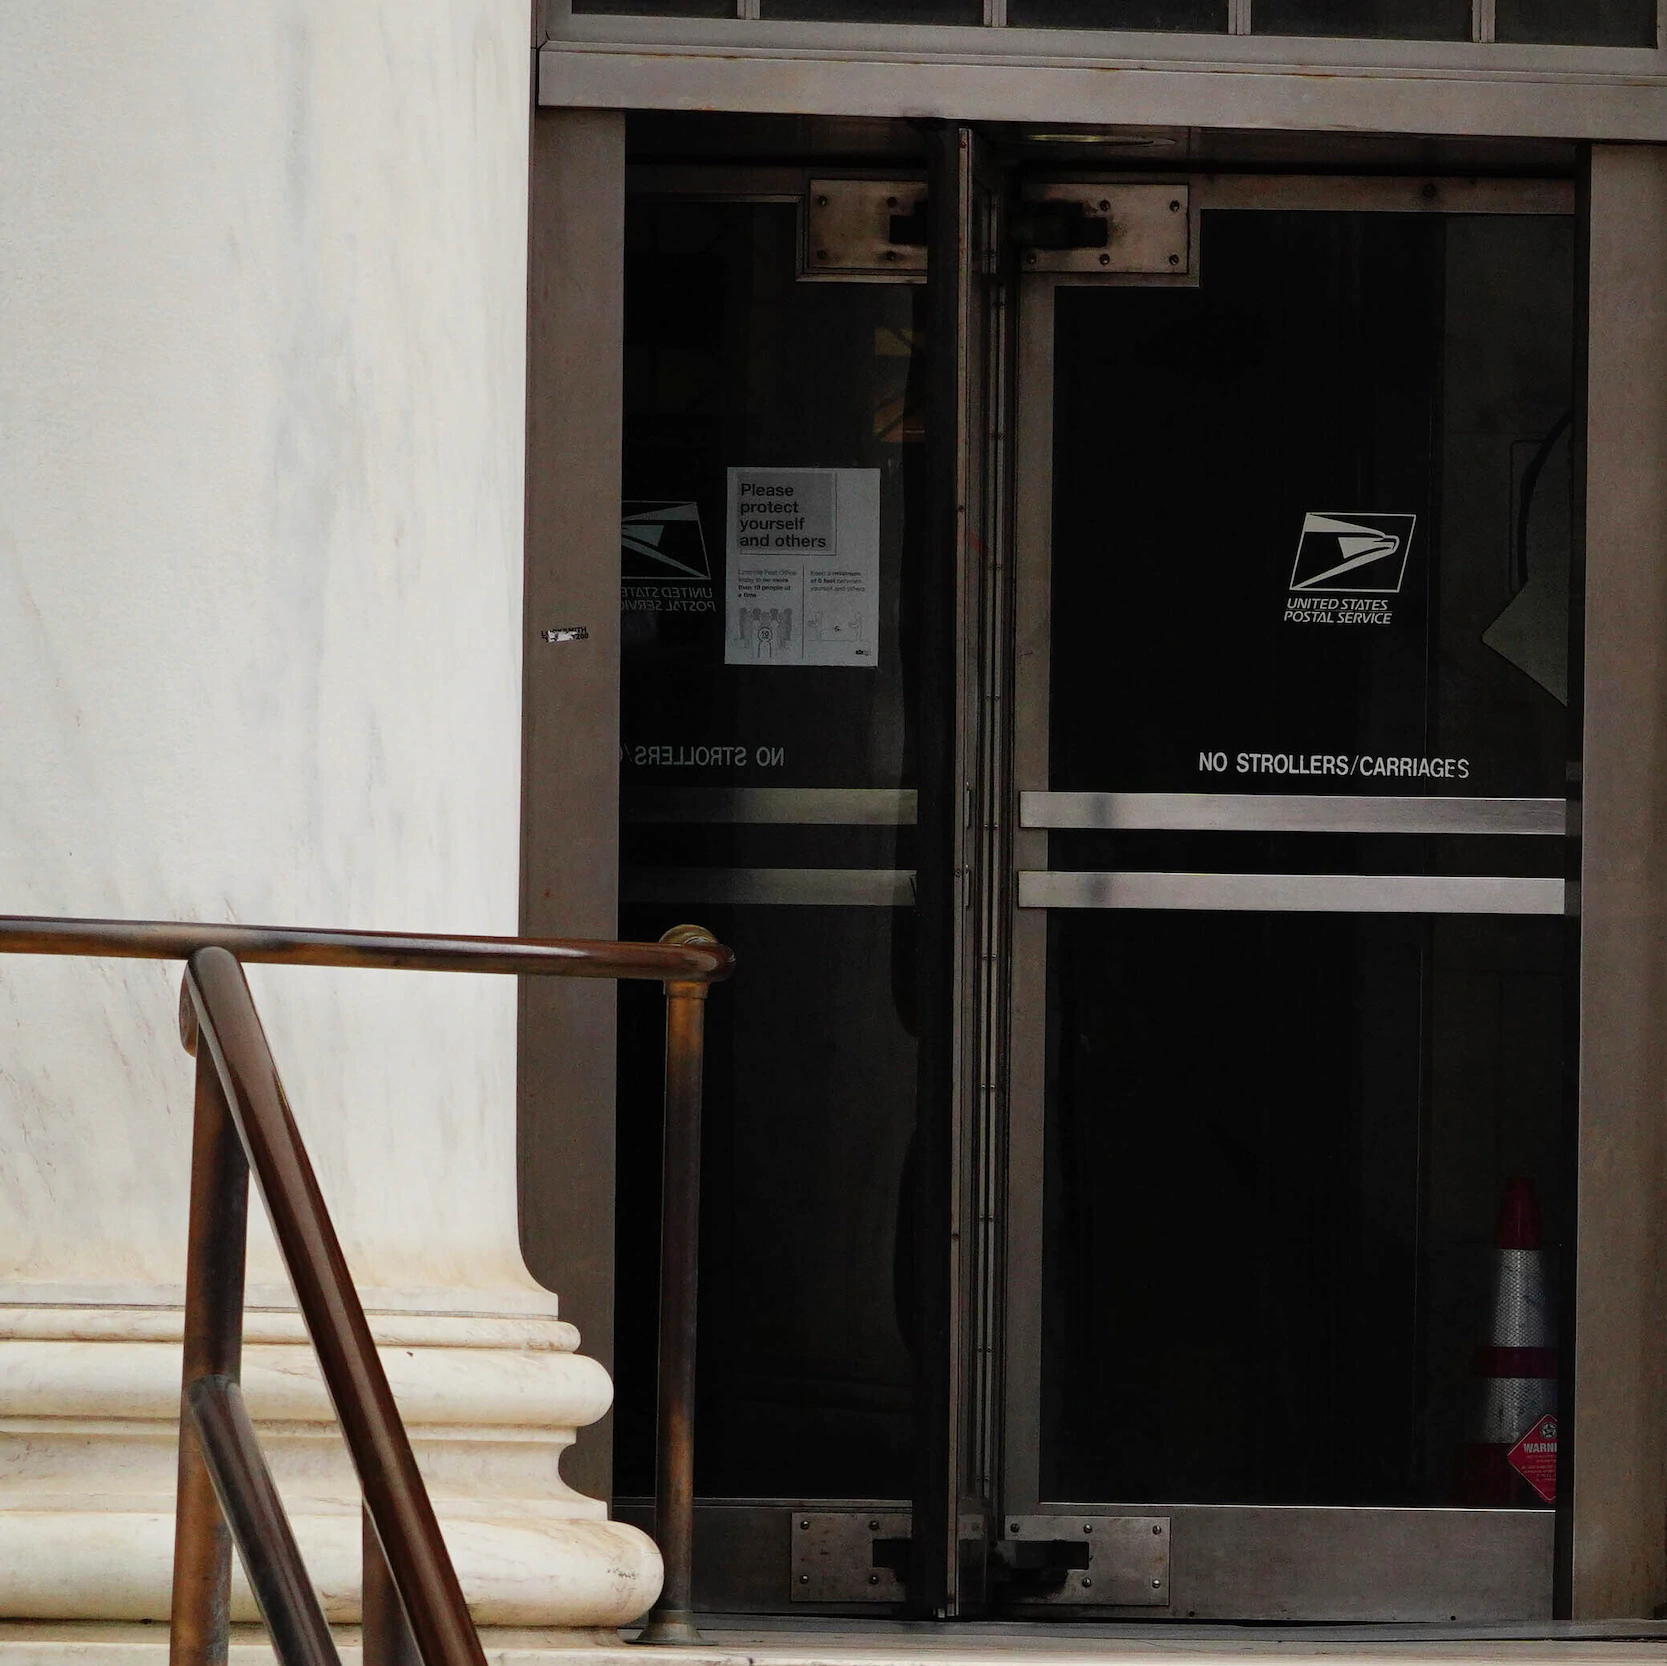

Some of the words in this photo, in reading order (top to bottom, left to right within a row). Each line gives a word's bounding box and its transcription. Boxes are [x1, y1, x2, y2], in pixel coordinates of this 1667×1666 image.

[741, 483, 794, 496] Please
[741, 500, 800, 516] protect
[740, 517, 806, 532] yourself
[740, 534, 770, 547] and
[775, 535, 827, 548] others
[1287, 598, 1339, 611] UNITED
[1341, 599, 1389, 611] STATES
[1283, 611, 1335, 624] POSTAL
[1337, 612, 1393, 624] SERVICE
[1199, 752, 1228, 773] NO
[1236, 752, 1470, 779] STROLLERS/CARRIAGES
